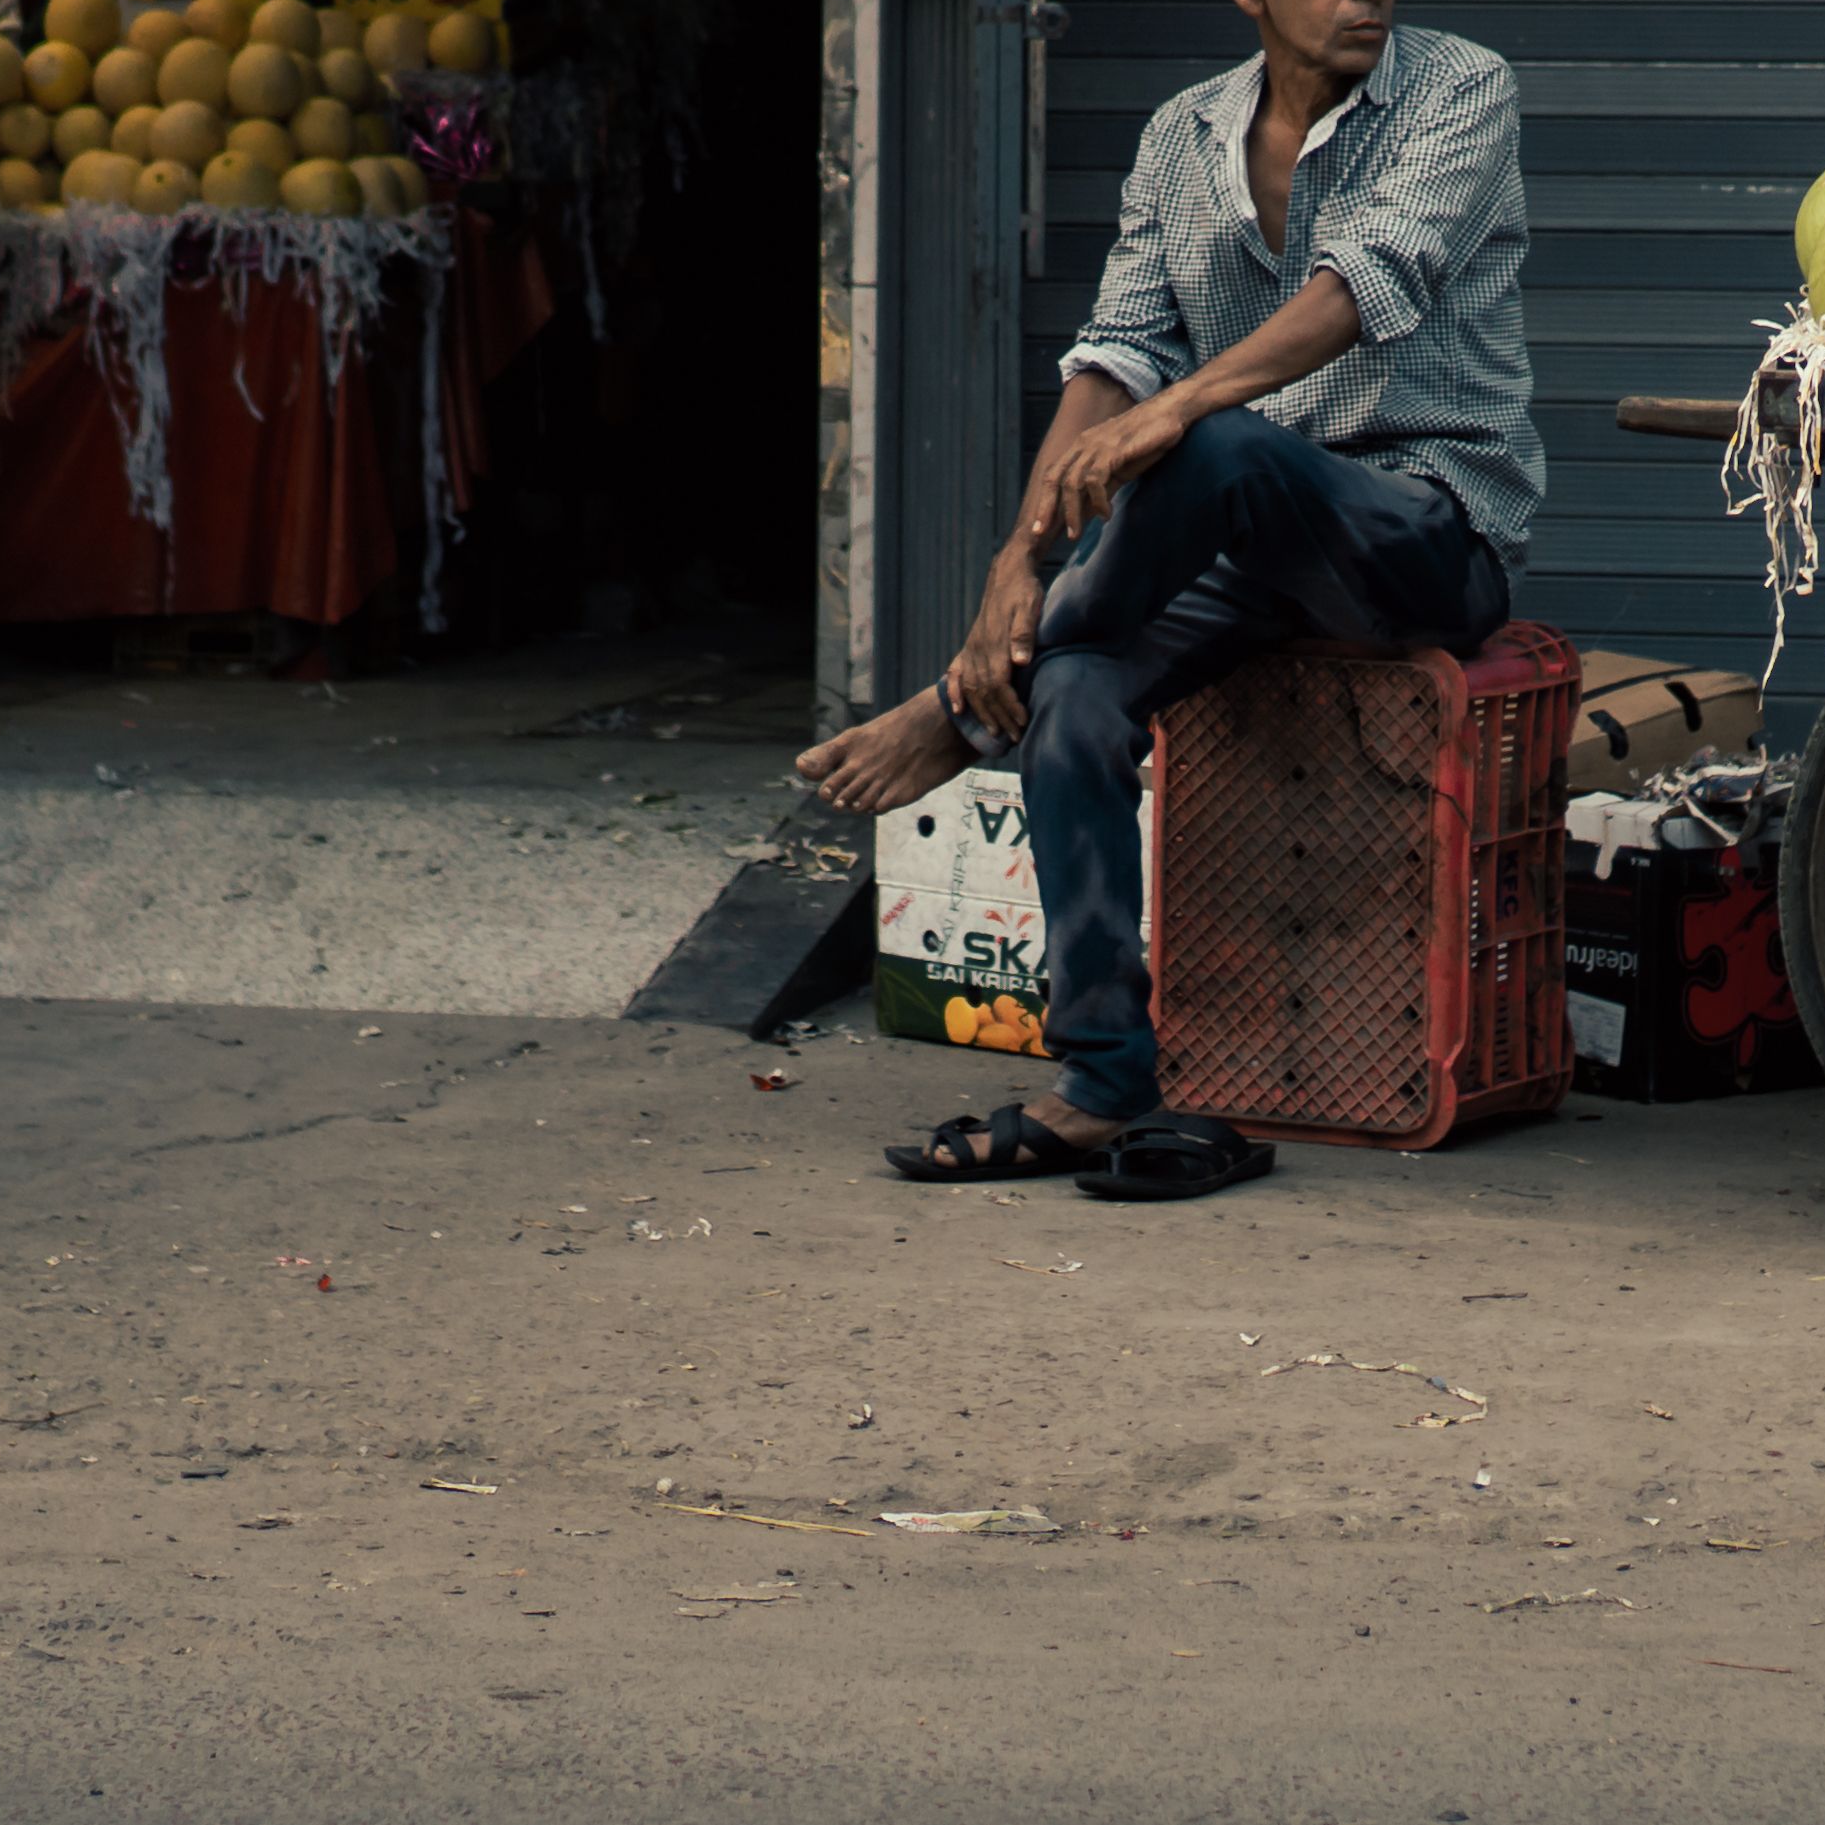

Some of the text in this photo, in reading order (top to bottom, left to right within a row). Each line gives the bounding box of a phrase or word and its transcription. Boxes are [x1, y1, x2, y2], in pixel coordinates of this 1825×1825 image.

[926, 962, 1041, 995] SAI KRIPA
[1565, 944, 1639, 979] ideafru
